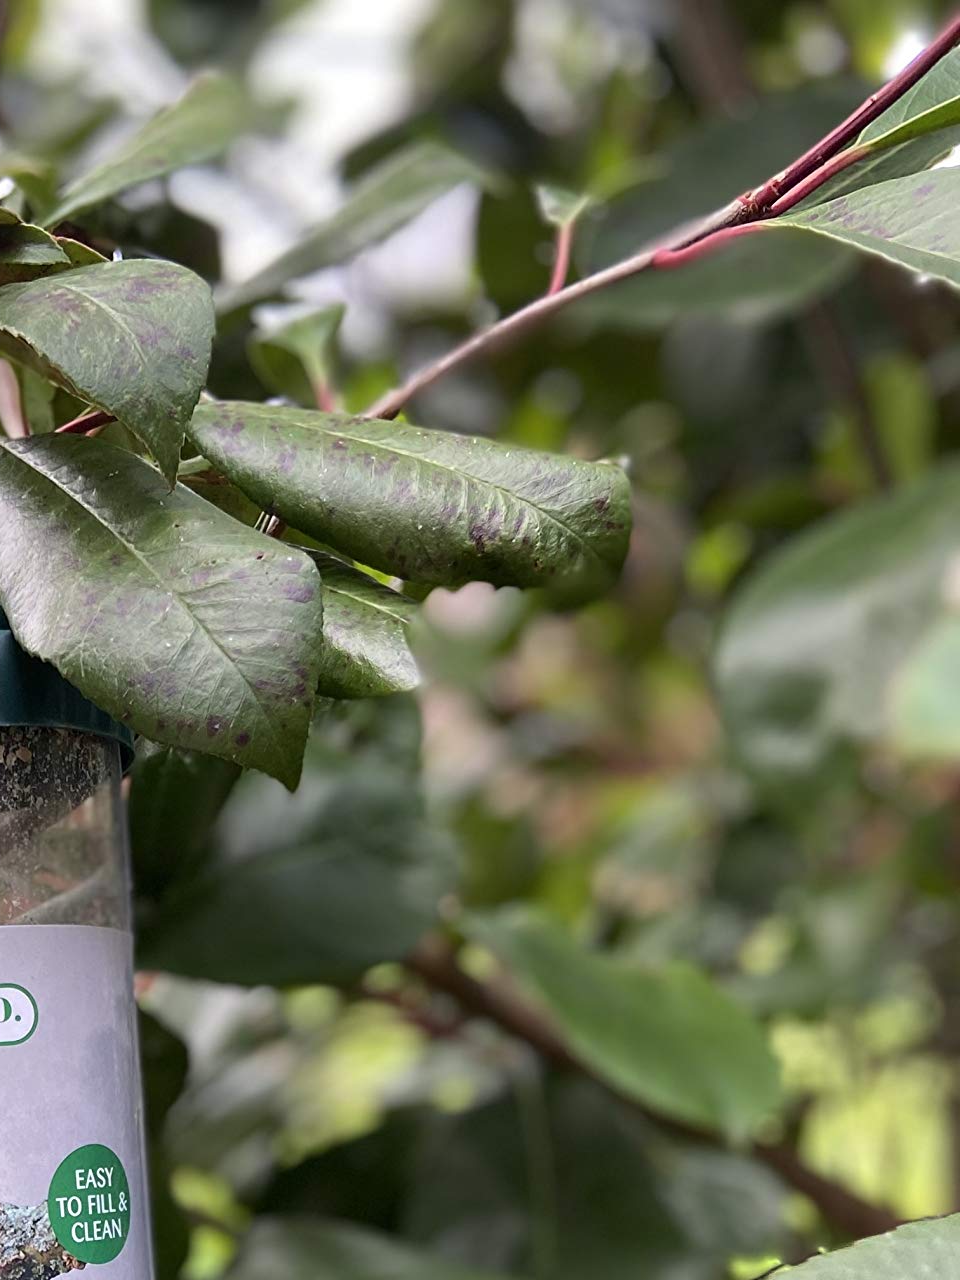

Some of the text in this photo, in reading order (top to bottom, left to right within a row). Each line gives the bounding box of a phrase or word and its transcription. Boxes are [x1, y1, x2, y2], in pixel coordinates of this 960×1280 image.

[75, 1167, 114, 1190] EASY
[55, 1191, 128, 1218] TO FILL &
[71, 1218, 122, 1243] CLEAN
